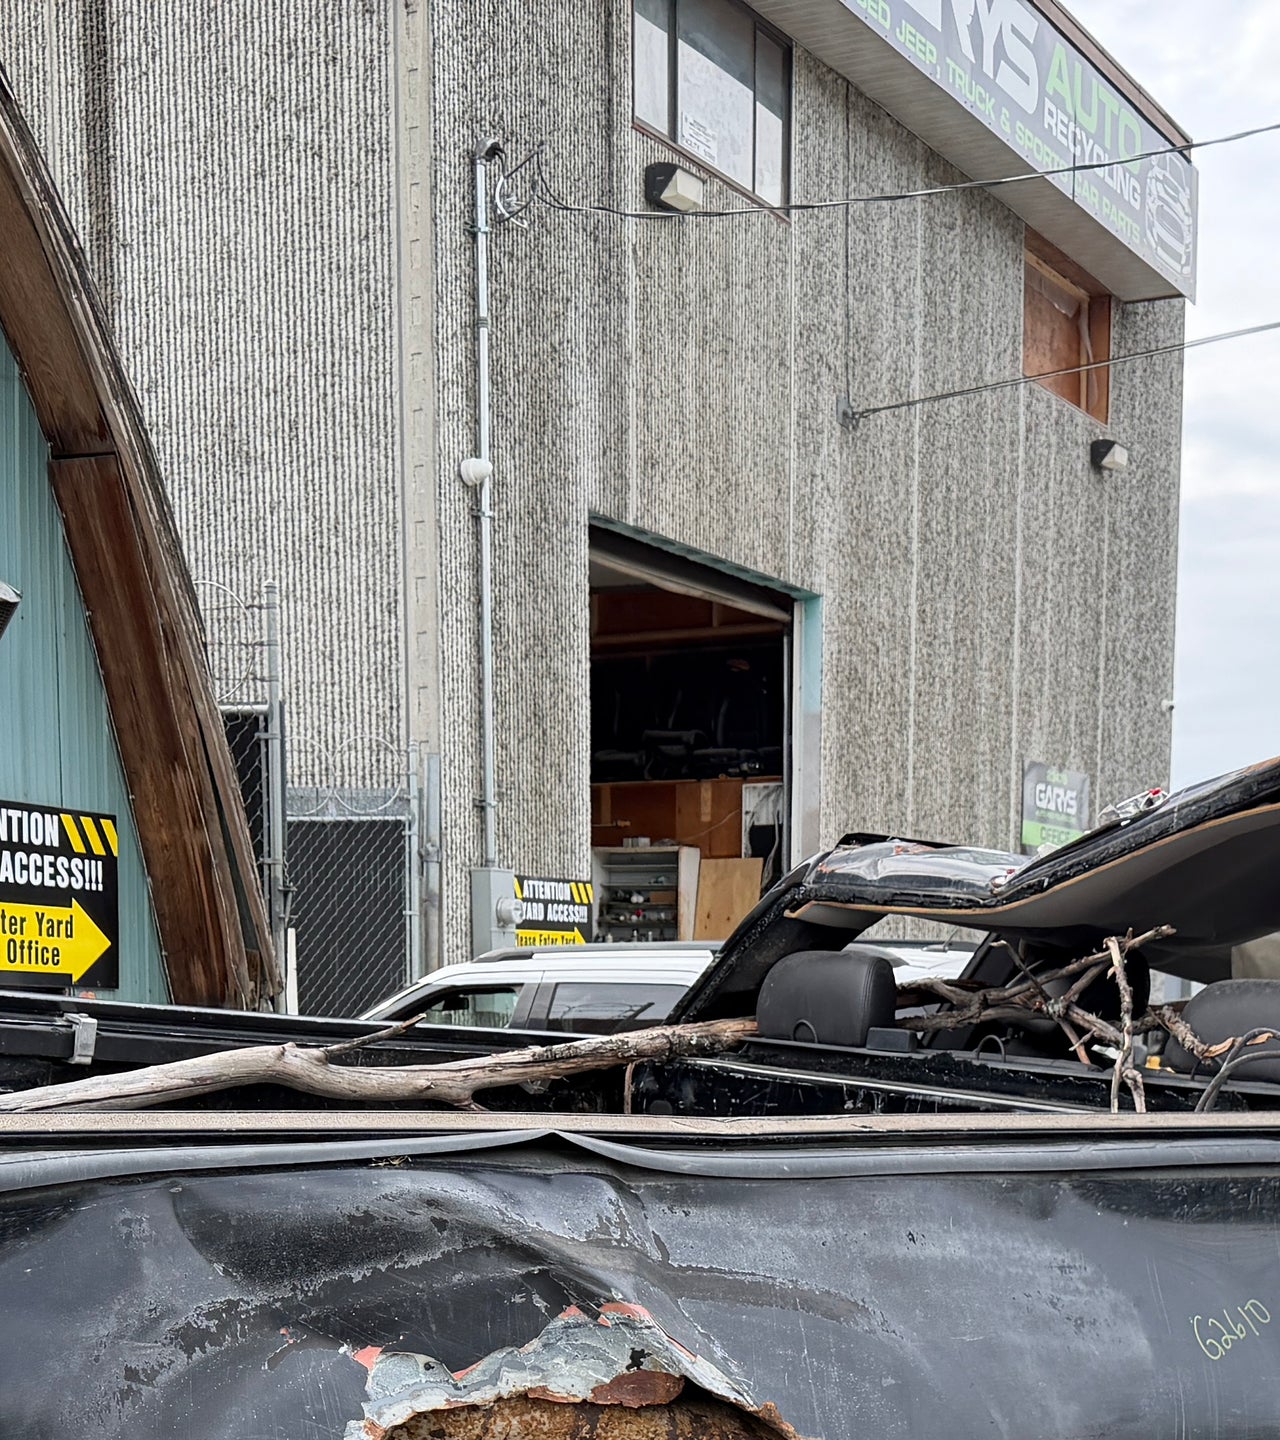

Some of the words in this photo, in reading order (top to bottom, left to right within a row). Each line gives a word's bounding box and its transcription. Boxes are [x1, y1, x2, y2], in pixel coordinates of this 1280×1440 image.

[1045, 41, 1141, 175] AUTO
[946, 57, 996, 120] TRUCK
[1000, 107, 1011, 133] &
[1015, 120, 1070, 184] SPORTS
[1075, 173, 1099, 210] CAR
[1103, 196, 1141, 243] PARTS
[1044, 97, 1141, 210] RECYCLING
[0, 849, 104, 892] ACCESS!!!
[522, 879, 571, 901] ATTENTION
[35, 911, 74, 939] Yard
[516, 932, 537, 947] lease
[7, 937, 61, 966] Office
